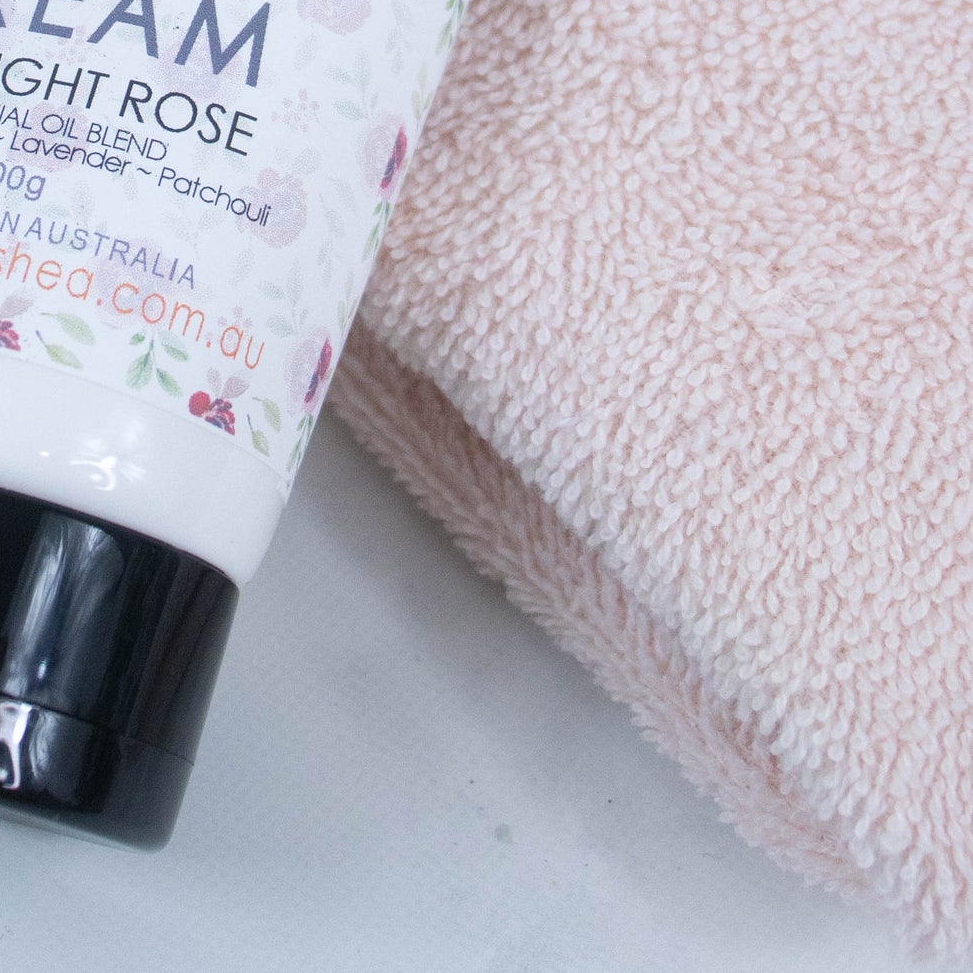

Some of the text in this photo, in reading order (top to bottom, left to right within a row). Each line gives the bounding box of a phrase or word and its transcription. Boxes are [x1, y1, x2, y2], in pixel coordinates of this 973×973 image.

[40, 113, 79, 140] OIL
[85, 122, 168, 162] BLEND
[118, 80, 260, 157] ROSE
[9, 130, 132, 176] Lavender
[157, 166, 273, 228] Patchouli
[23, 217, 197, 290] AUSTRALIA
